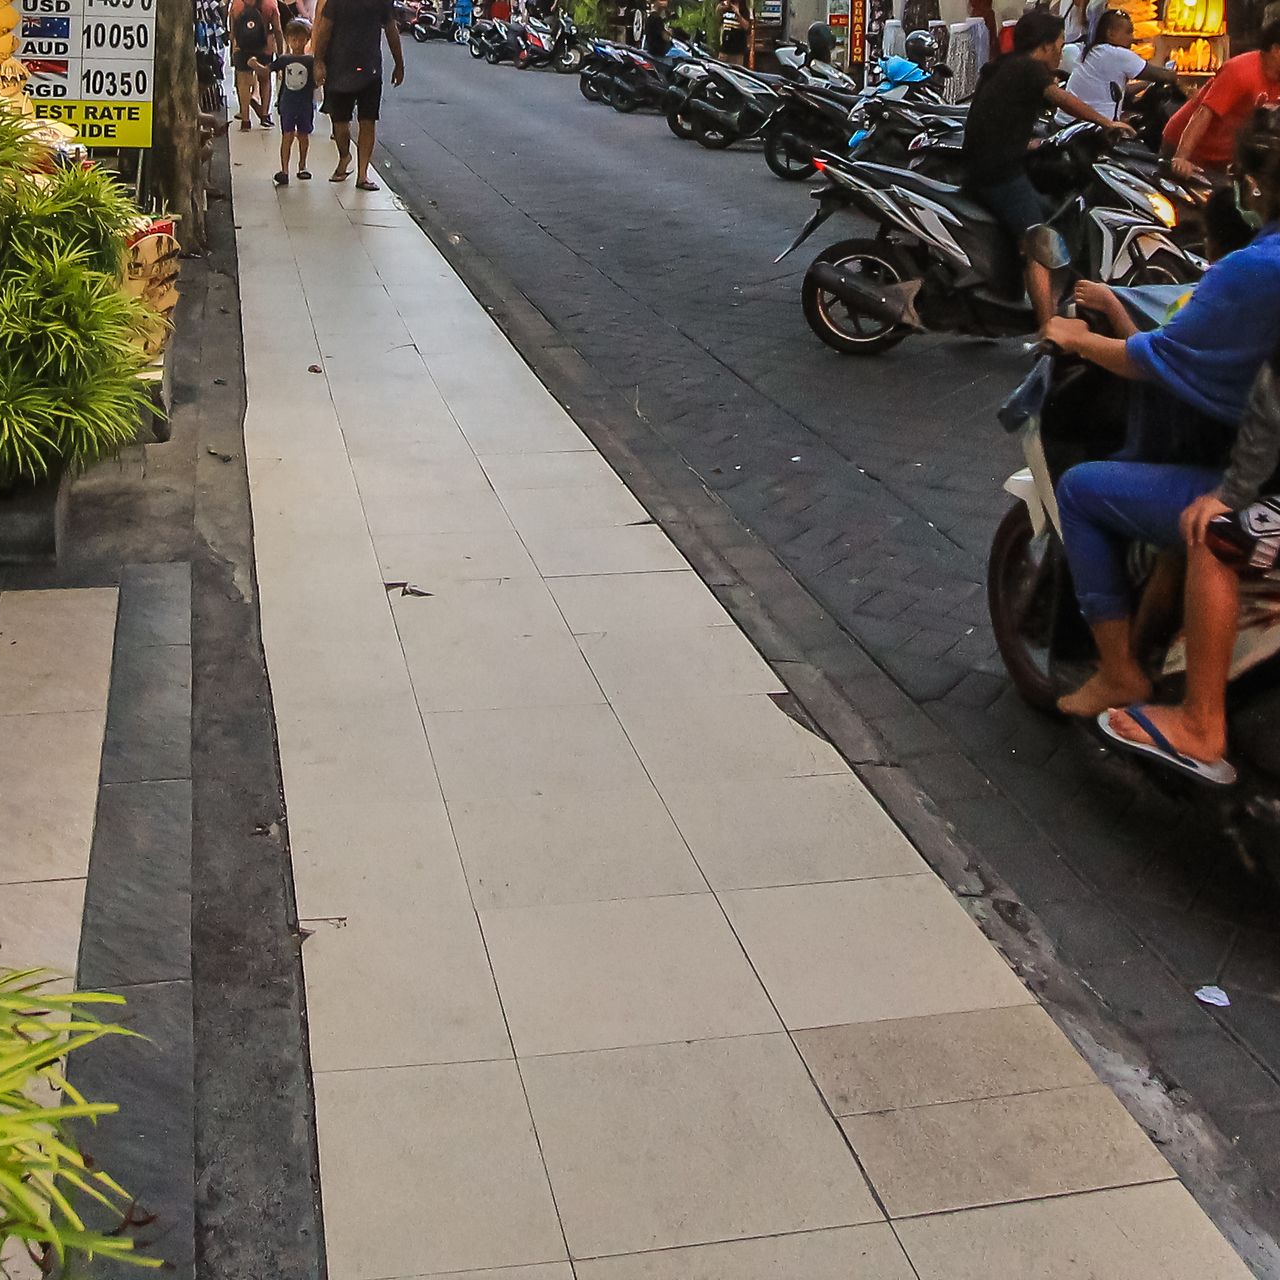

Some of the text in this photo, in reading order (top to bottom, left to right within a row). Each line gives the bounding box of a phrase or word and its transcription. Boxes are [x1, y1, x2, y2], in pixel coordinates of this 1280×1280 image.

[21, 22, 149, 55] AUD 10050
[22, 68, 147, 98] SGD 10350
[35, 105, 140, 121] EST RATE
